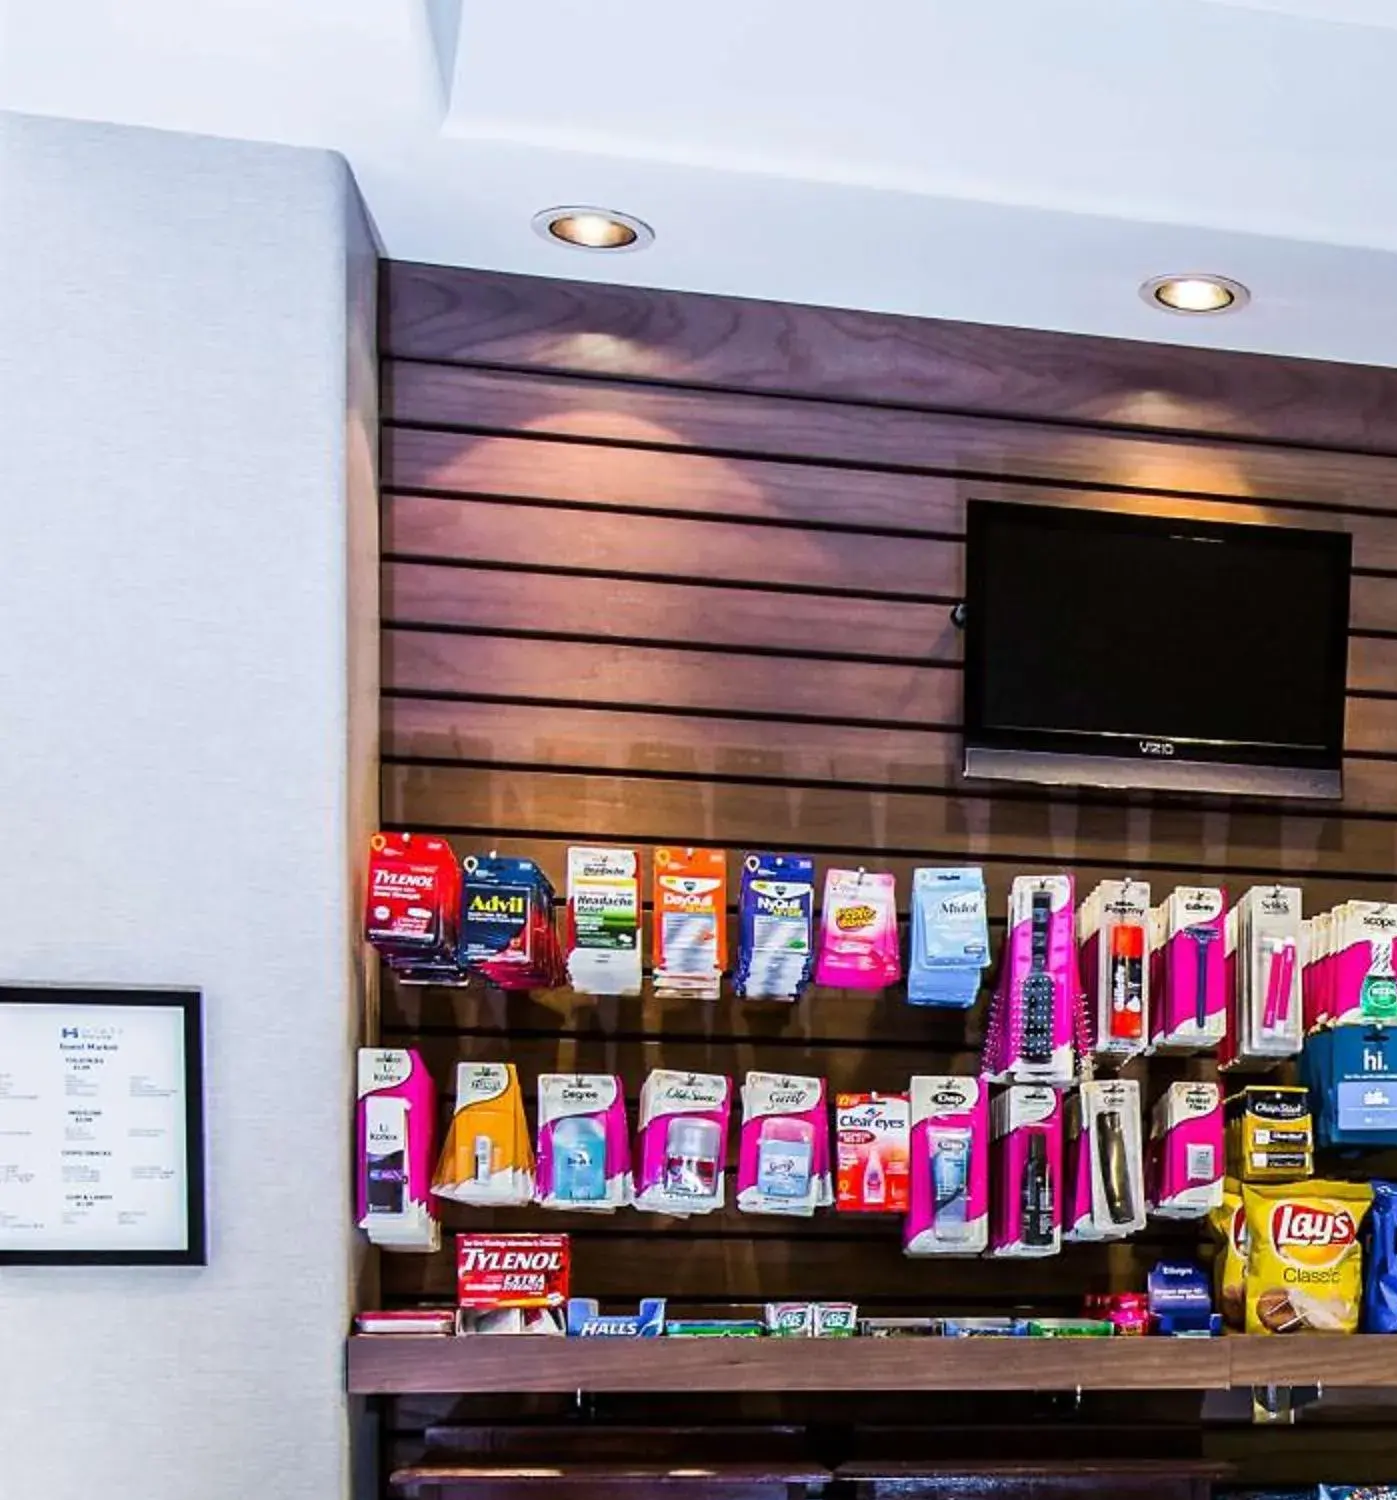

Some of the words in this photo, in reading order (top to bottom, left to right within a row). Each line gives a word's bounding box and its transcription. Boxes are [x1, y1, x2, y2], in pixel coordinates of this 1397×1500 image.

[1138, 741, 1175, 755] VIZIO
[373, 869, 435, 888] TYLENOL
[470, 896, 524, 914] Advil
[1363, 916, 1397, 928] scope
[1363, 1048, 1388, 1071] hi.
[561, 1089, 599, 1101] Degree
[839, 1115, 873, 1127] Clear
[874, 1118, 905, 1131] eyes
[1277, 1206, 1350, 1246] Lay's
[462, 1249, 561, 1270] TYLENOL
[1283, 1267, 1340, 1283] Classic
[580, 1321, 638, 1336] HALLS
